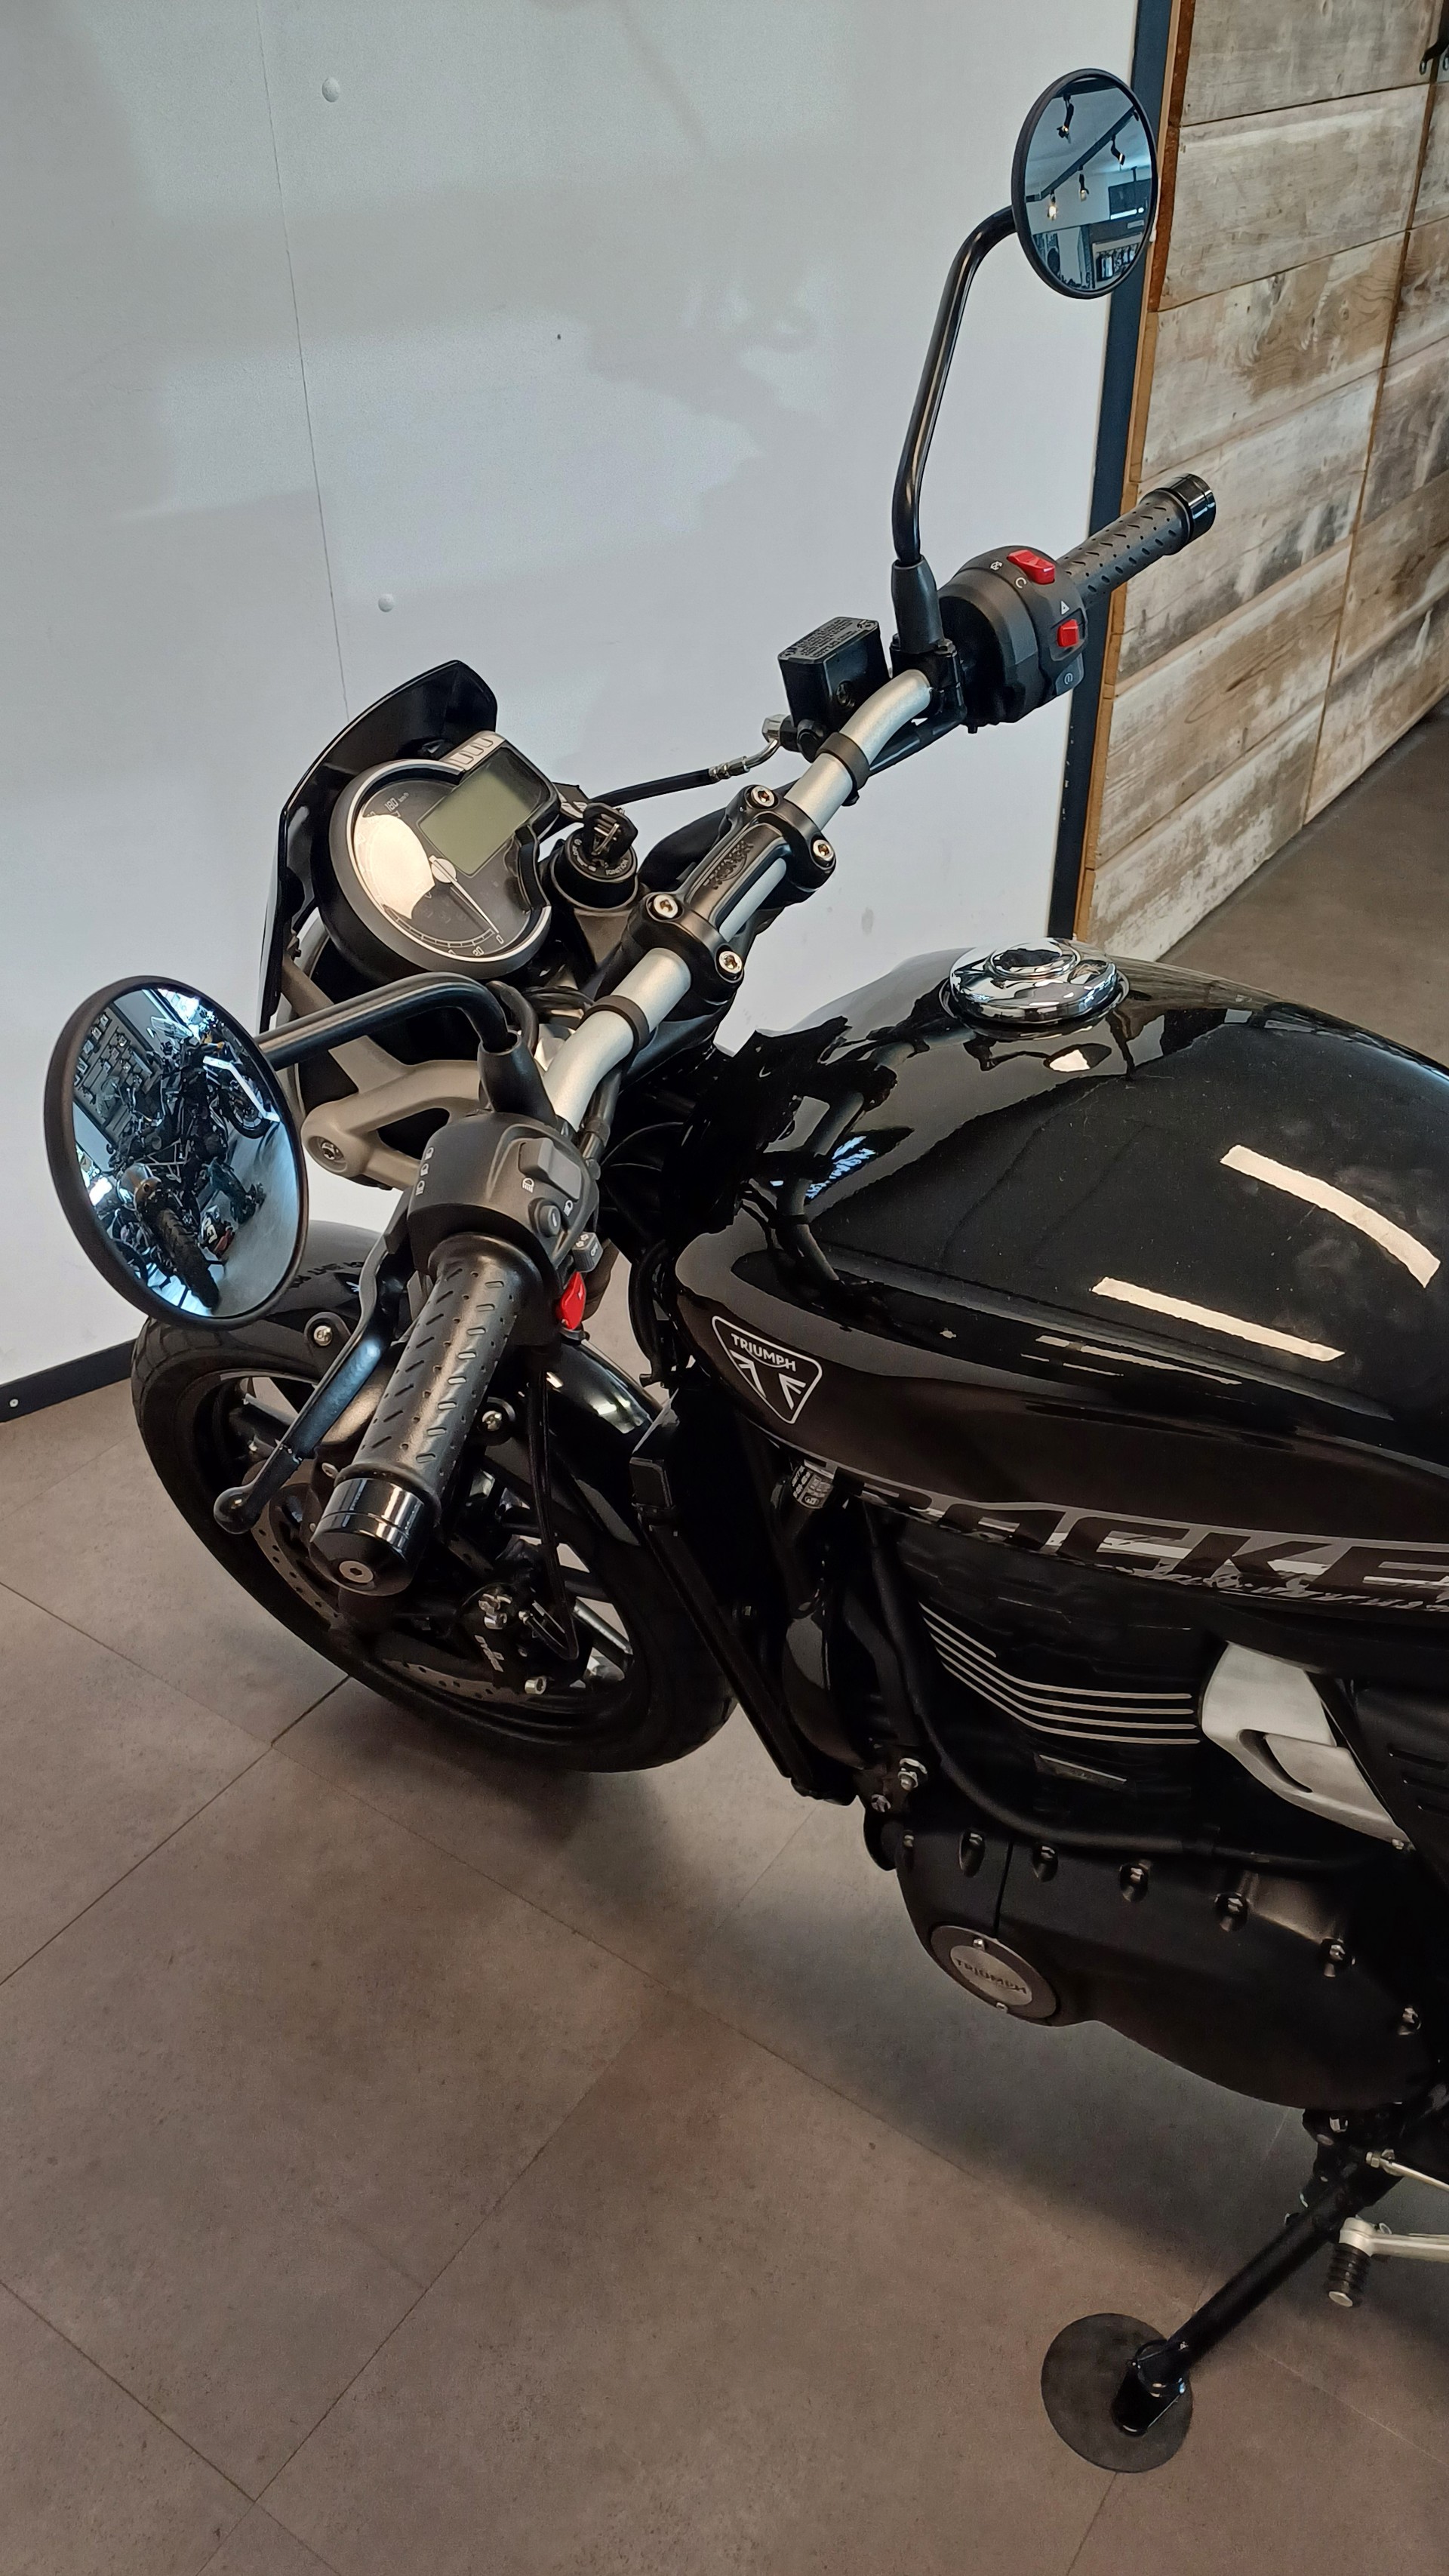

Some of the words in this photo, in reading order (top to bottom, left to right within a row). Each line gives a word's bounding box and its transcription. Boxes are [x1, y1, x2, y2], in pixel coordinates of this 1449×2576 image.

[384, 797, 399, 812] 180
[731, 1333, 796, 1372] TRIUMPH
[955, 1958, 1028, 1995] TRIUMPH
